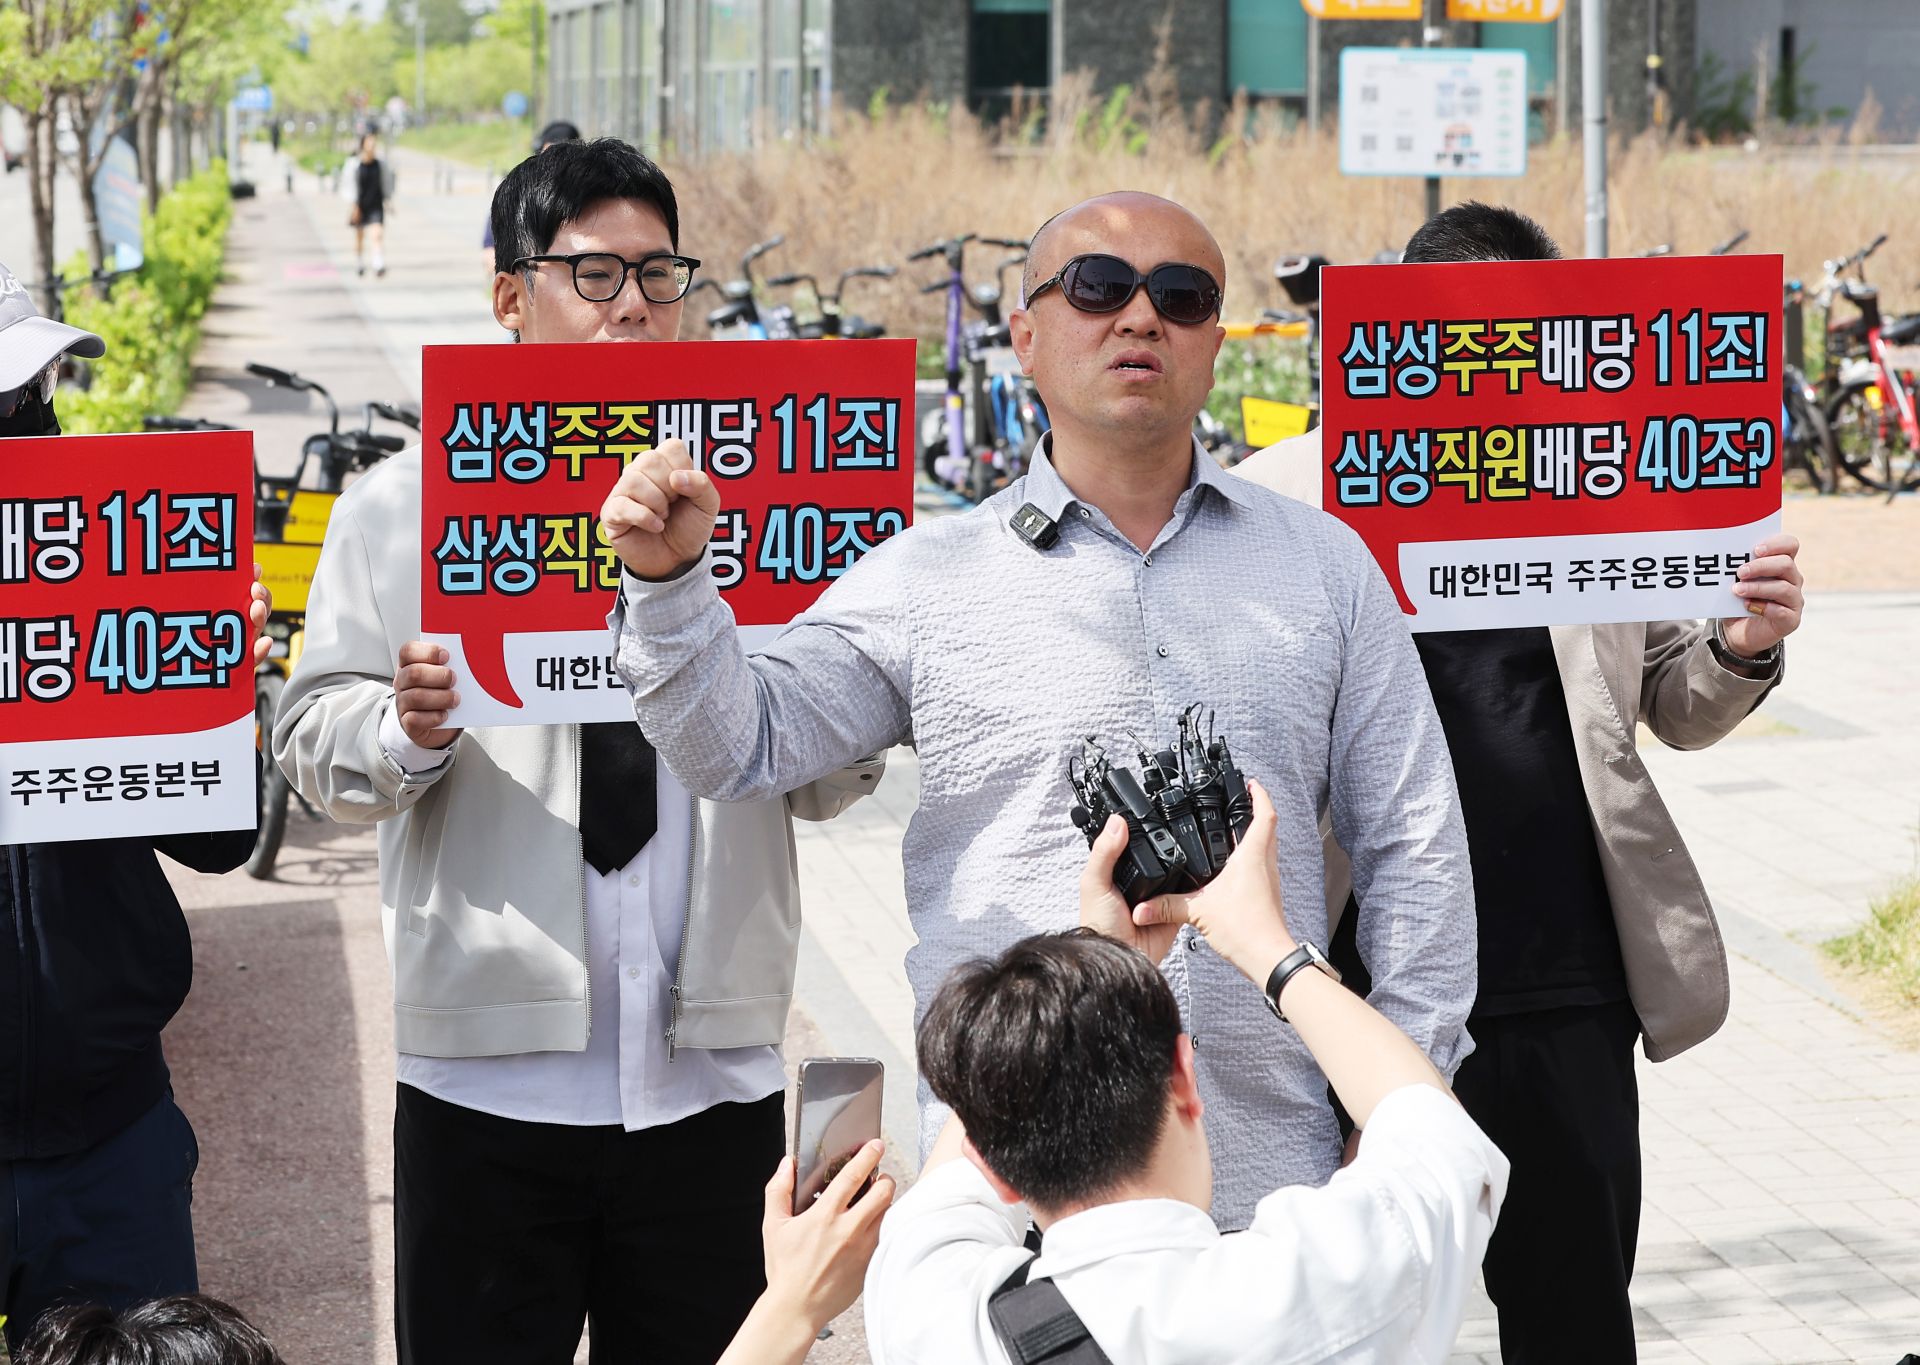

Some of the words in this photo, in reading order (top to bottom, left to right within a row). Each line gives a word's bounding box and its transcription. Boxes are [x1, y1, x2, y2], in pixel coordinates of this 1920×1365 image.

[1339, 313, 1638, 398] 삼성주주배당
[1646, 307, 1769, 386] 11조!
[769, 393, 902, 472] 11조!
[1331, 421, 1631, 508] 삼성직원배당
[1634, 414, 1775, 493] 40조?
[98, 489, 238, 576] 11조!
[432, 511, 752, 596] 삼성직당
[1429, 562, 1553, 598] 대한민국
[1567, 553, 1750, 592] 주주운동본부
[85, 606, 247, 694] 40조?
[10, 759, 222, 806] 주주운동본부
